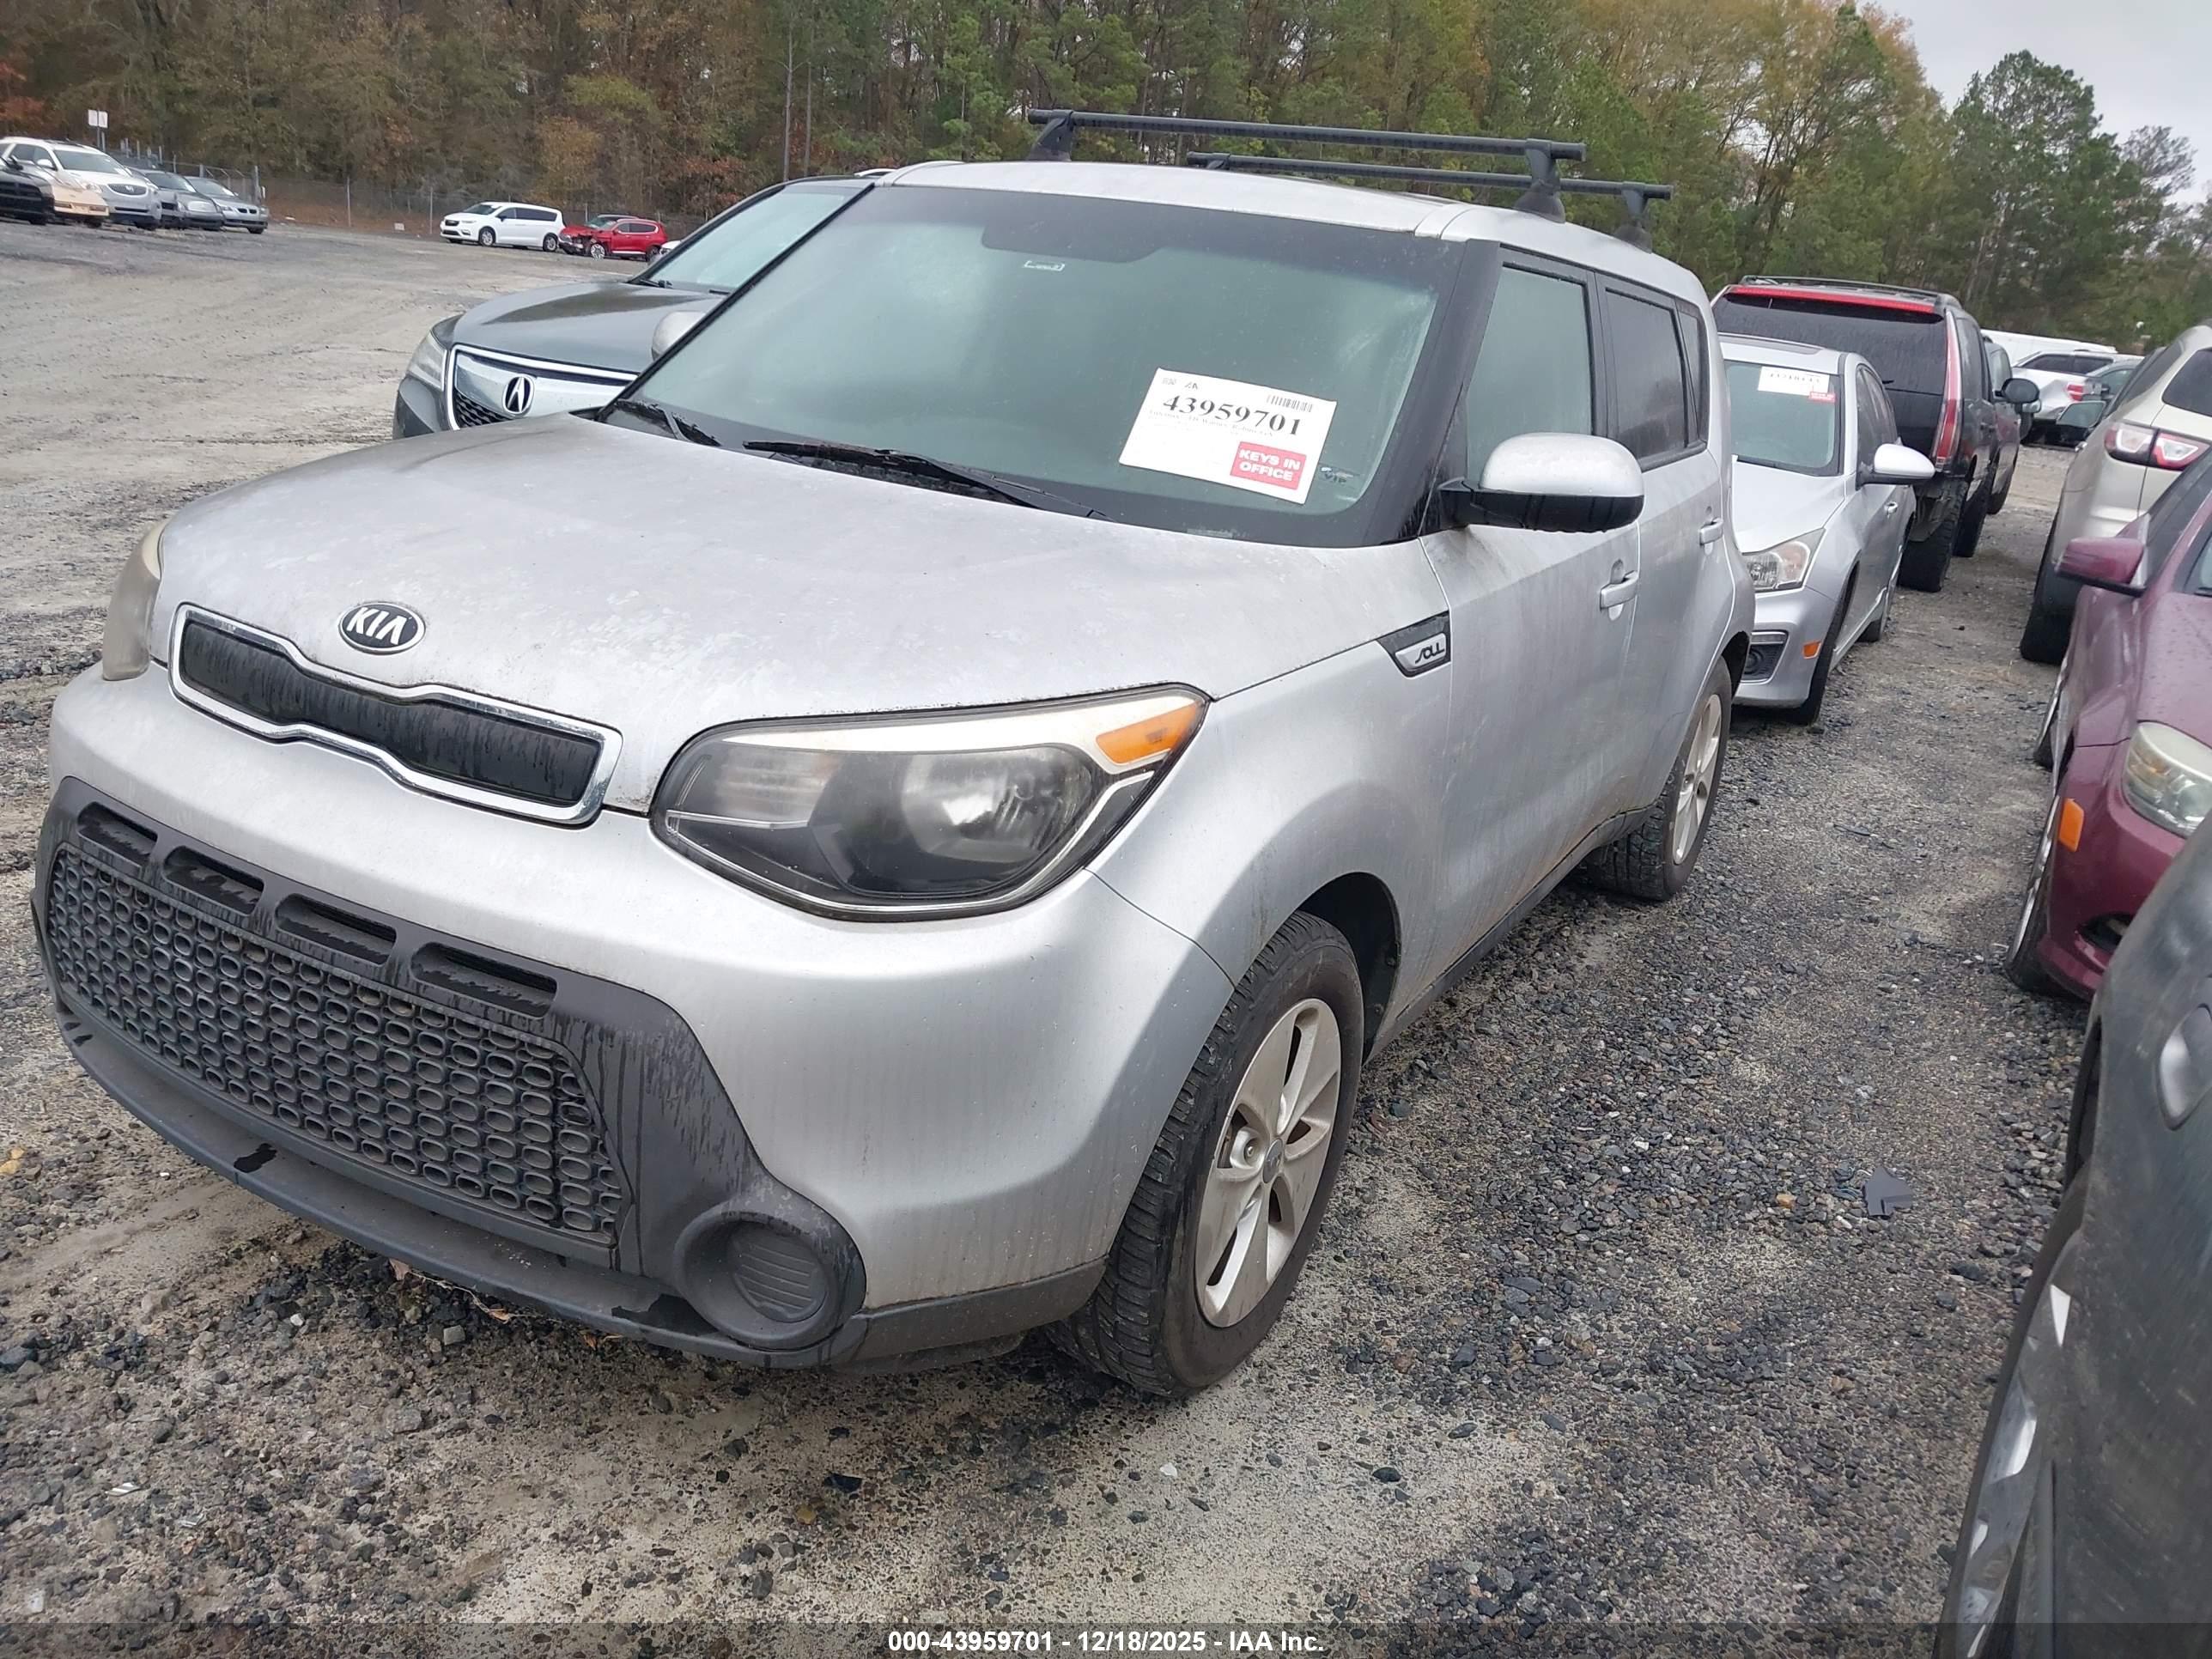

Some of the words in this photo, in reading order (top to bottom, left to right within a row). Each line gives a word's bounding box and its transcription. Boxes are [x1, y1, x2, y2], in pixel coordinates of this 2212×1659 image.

[1163, 395, 1302, 436] 43959701
[1238, 461, 1293, 481] OFFICE
[1239, 449, 1280, 466] KEYS
[1283, 458, 1302, 471] IN
[346, 606, 407, 646] KIA
